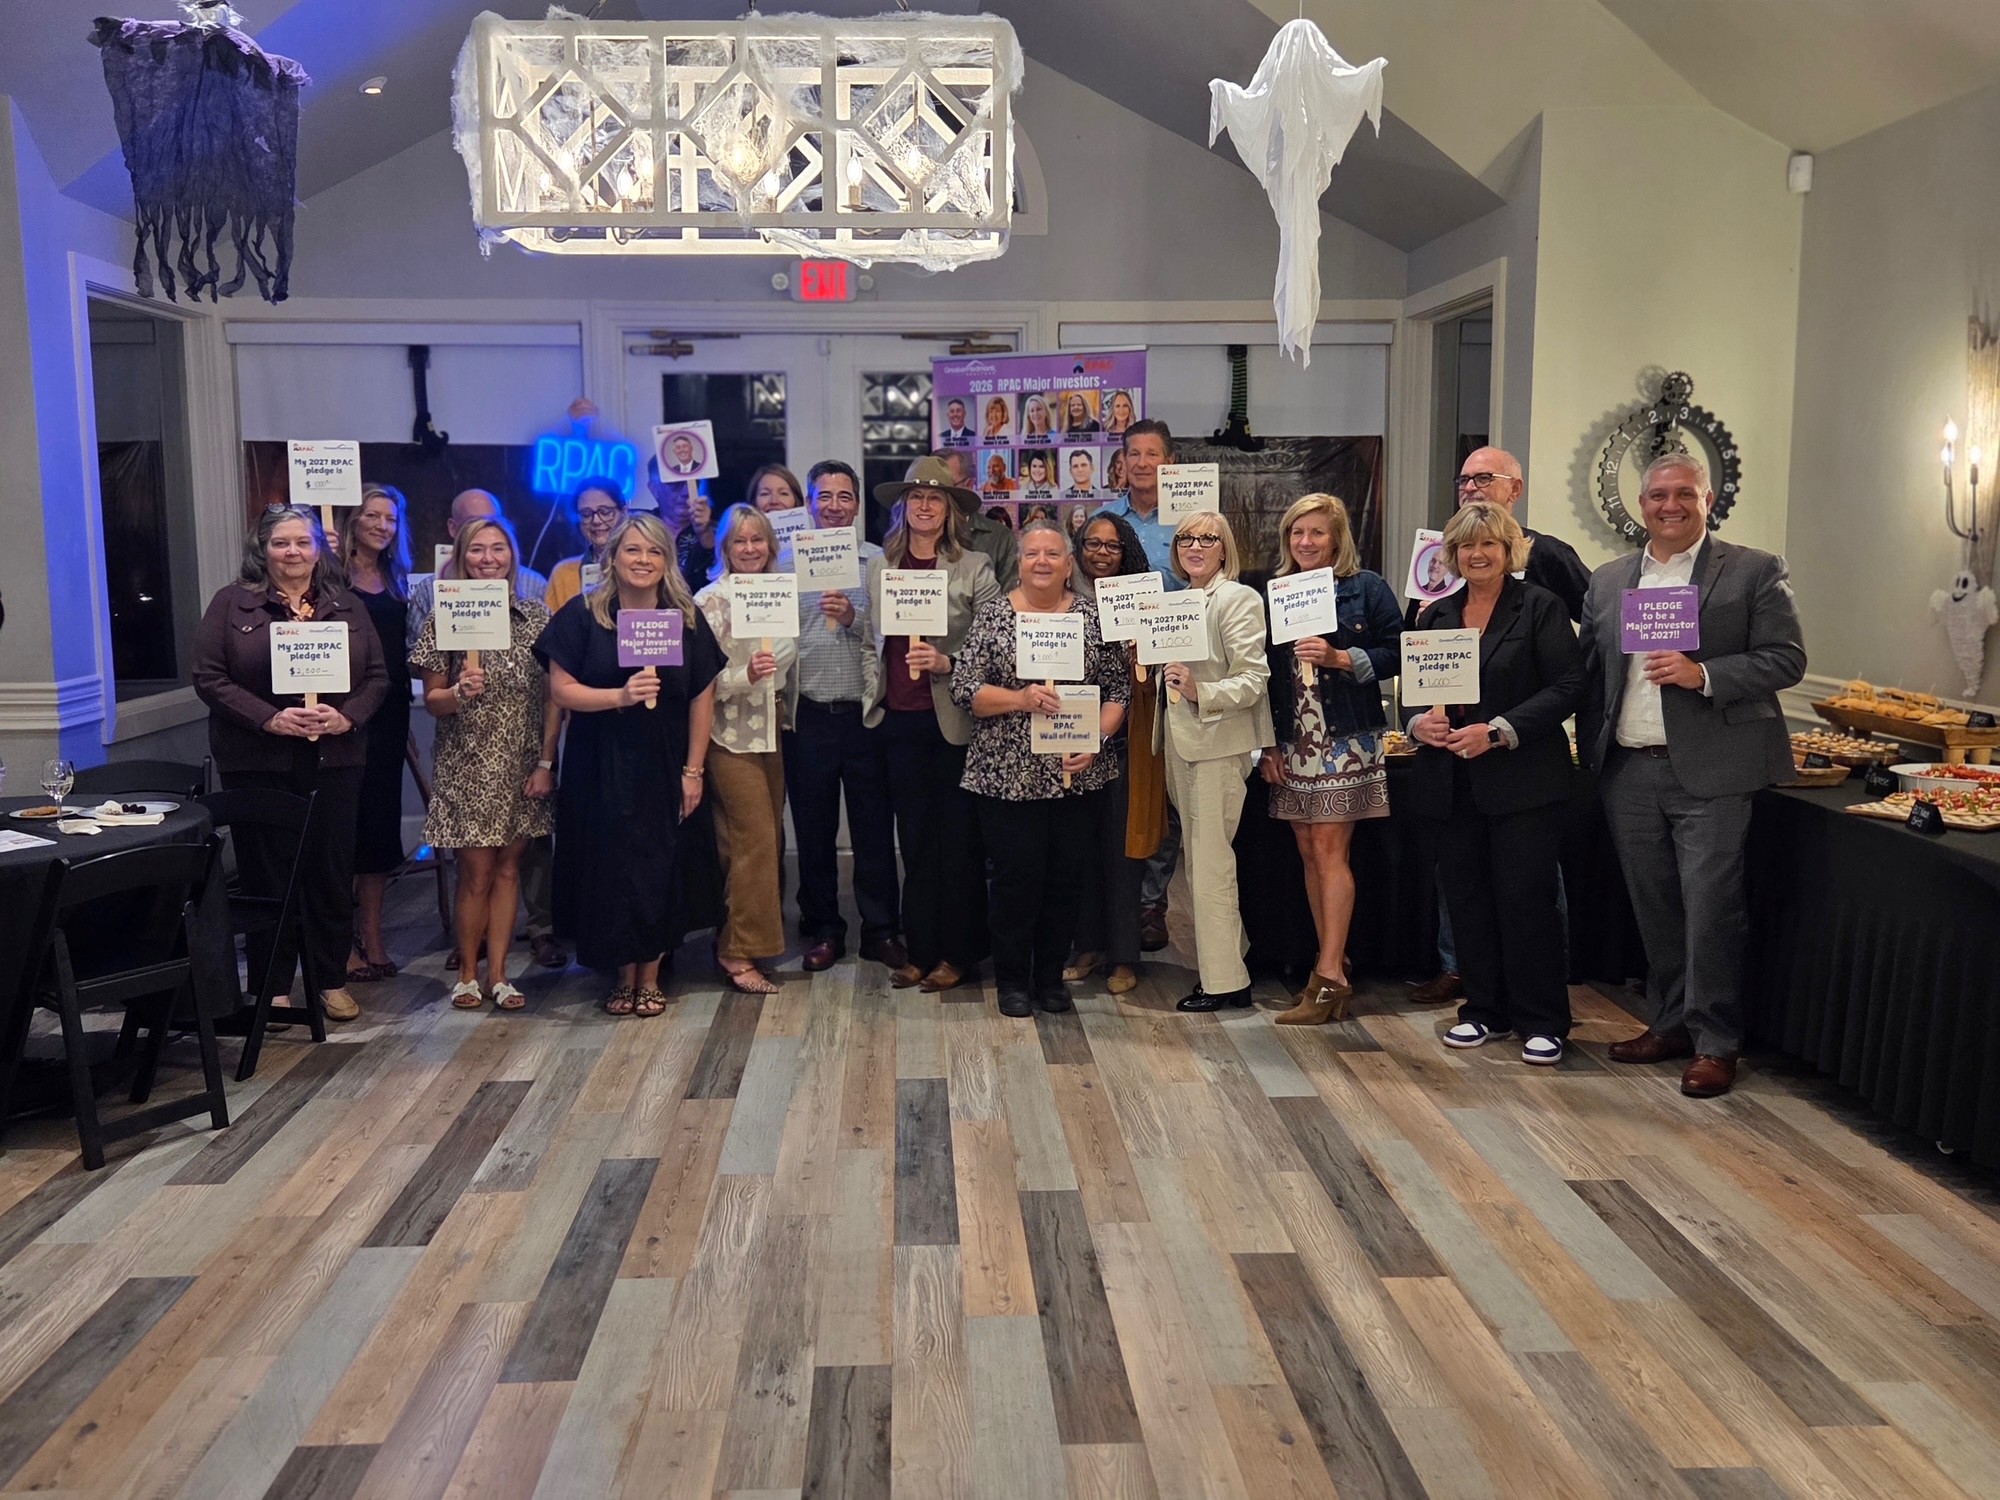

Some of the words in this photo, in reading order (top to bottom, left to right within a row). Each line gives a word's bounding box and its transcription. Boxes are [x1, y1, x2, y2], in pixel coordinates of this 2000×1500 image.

[802, 261, 847, 299] EXIT
[969, 380, 993, 393] 2026
[998, 378, 1021, 392] RPAC
[1023, 377, 1051, 391] Major
[1053, 375, 1100, 389] Investors
[1648, 411, 1659, 424] 2
[1679, 407, 1689, 420] 3
[1706, 422, 1717, 433] 4
[1622, 432, 1631, 441] 1
[1723, 449, 1735, 459] 5
[294, 459, 307, 468] My
[536, 438, 632, 493] RPAC
[1606, 461, 1619, 475] 12
[306, 467, 334, 475] pledge
[1162, 482, 1173, 490] My
[1724, 483, 1735, 493] 6
[1171, 489, 1196, 498] pledge
[1607, 495, 1620, 509] 11
[786, 524, 805, 533] RPAC
[1624, 521, 1638, 536] 10
[778, 535, 791, 543] dge
[798, 548, 809, 556] My
[811, 546, 828, 554] 2027
[830, 544, 852, 552] RPAC
[808, 554, 834, 563] pledge
[735, 592, 747, 600] My
[886, 588, 897, 597] My
[1274, 597, 1285, 605] My
[1286, 592, 1303, 601] 2027
[1306, 587, 1328, 597] RPAC
[746, 600, 773, 608] pledge
[896, 597, 923, 606] pledge
[1101, 596, 1113, 604] My
[1115, 594, 1134, 602] 2027
[440, 601, 453, 609] My
[478, 600, 503, 608] RPAC
[1284, 600, 1309, 612] pledge
[1639, 603, 1642, 611] I
[1644, 601, 1683, 611] PLEDGE
[452, 610, 481, 619] pledge
[1642, 612, 1653, 620] to
[1656, 611, 1667, 620] be
[631, 621, 635, 629] I
[636, 621, 670, 629] PLEDGE
[1140, 618, 1152, 626] My
[1176, 614, 1200, 622] RPAC
[1152, 624, 1180, 634] pledge
[1626, 622, 1652, 632] Major
[1655, 621, 1695, 629] Investor
[635, 630, 645, 638] to
[646, 630, 657, 638] be
[1021, 631, 1033, 640] My
[1056, 632, 1078, 640] RPAC
[1640, 631, 1649, 640] in
[1651, 630, 1680, 639] 2027!!
[277, 644, 291, 652] My
[621, 639, 644, 649] Major
[646, 638, 680, 646] Investor
[1032, 640, 1059, 649] pledge
[633, 647, 642, 655] in
[642, 647, 668, 655] 2027!!
[290, 652, 320, 662] pledge
[1407, 654, 1420, 663] My
[1422, 653, 1444, 661] 2027
[1446, 652, 1472, 660] RPAC
[1419, 662, 1450, 672] pledge
[1452, 661, 1460, 669] is
[1053, 722, 1075, 730] RPAC
[1040, 732, 1058, 740] Wall
[1059, 732, 1067, 740] of
[1067, 732, 1090, 740] Fame!
